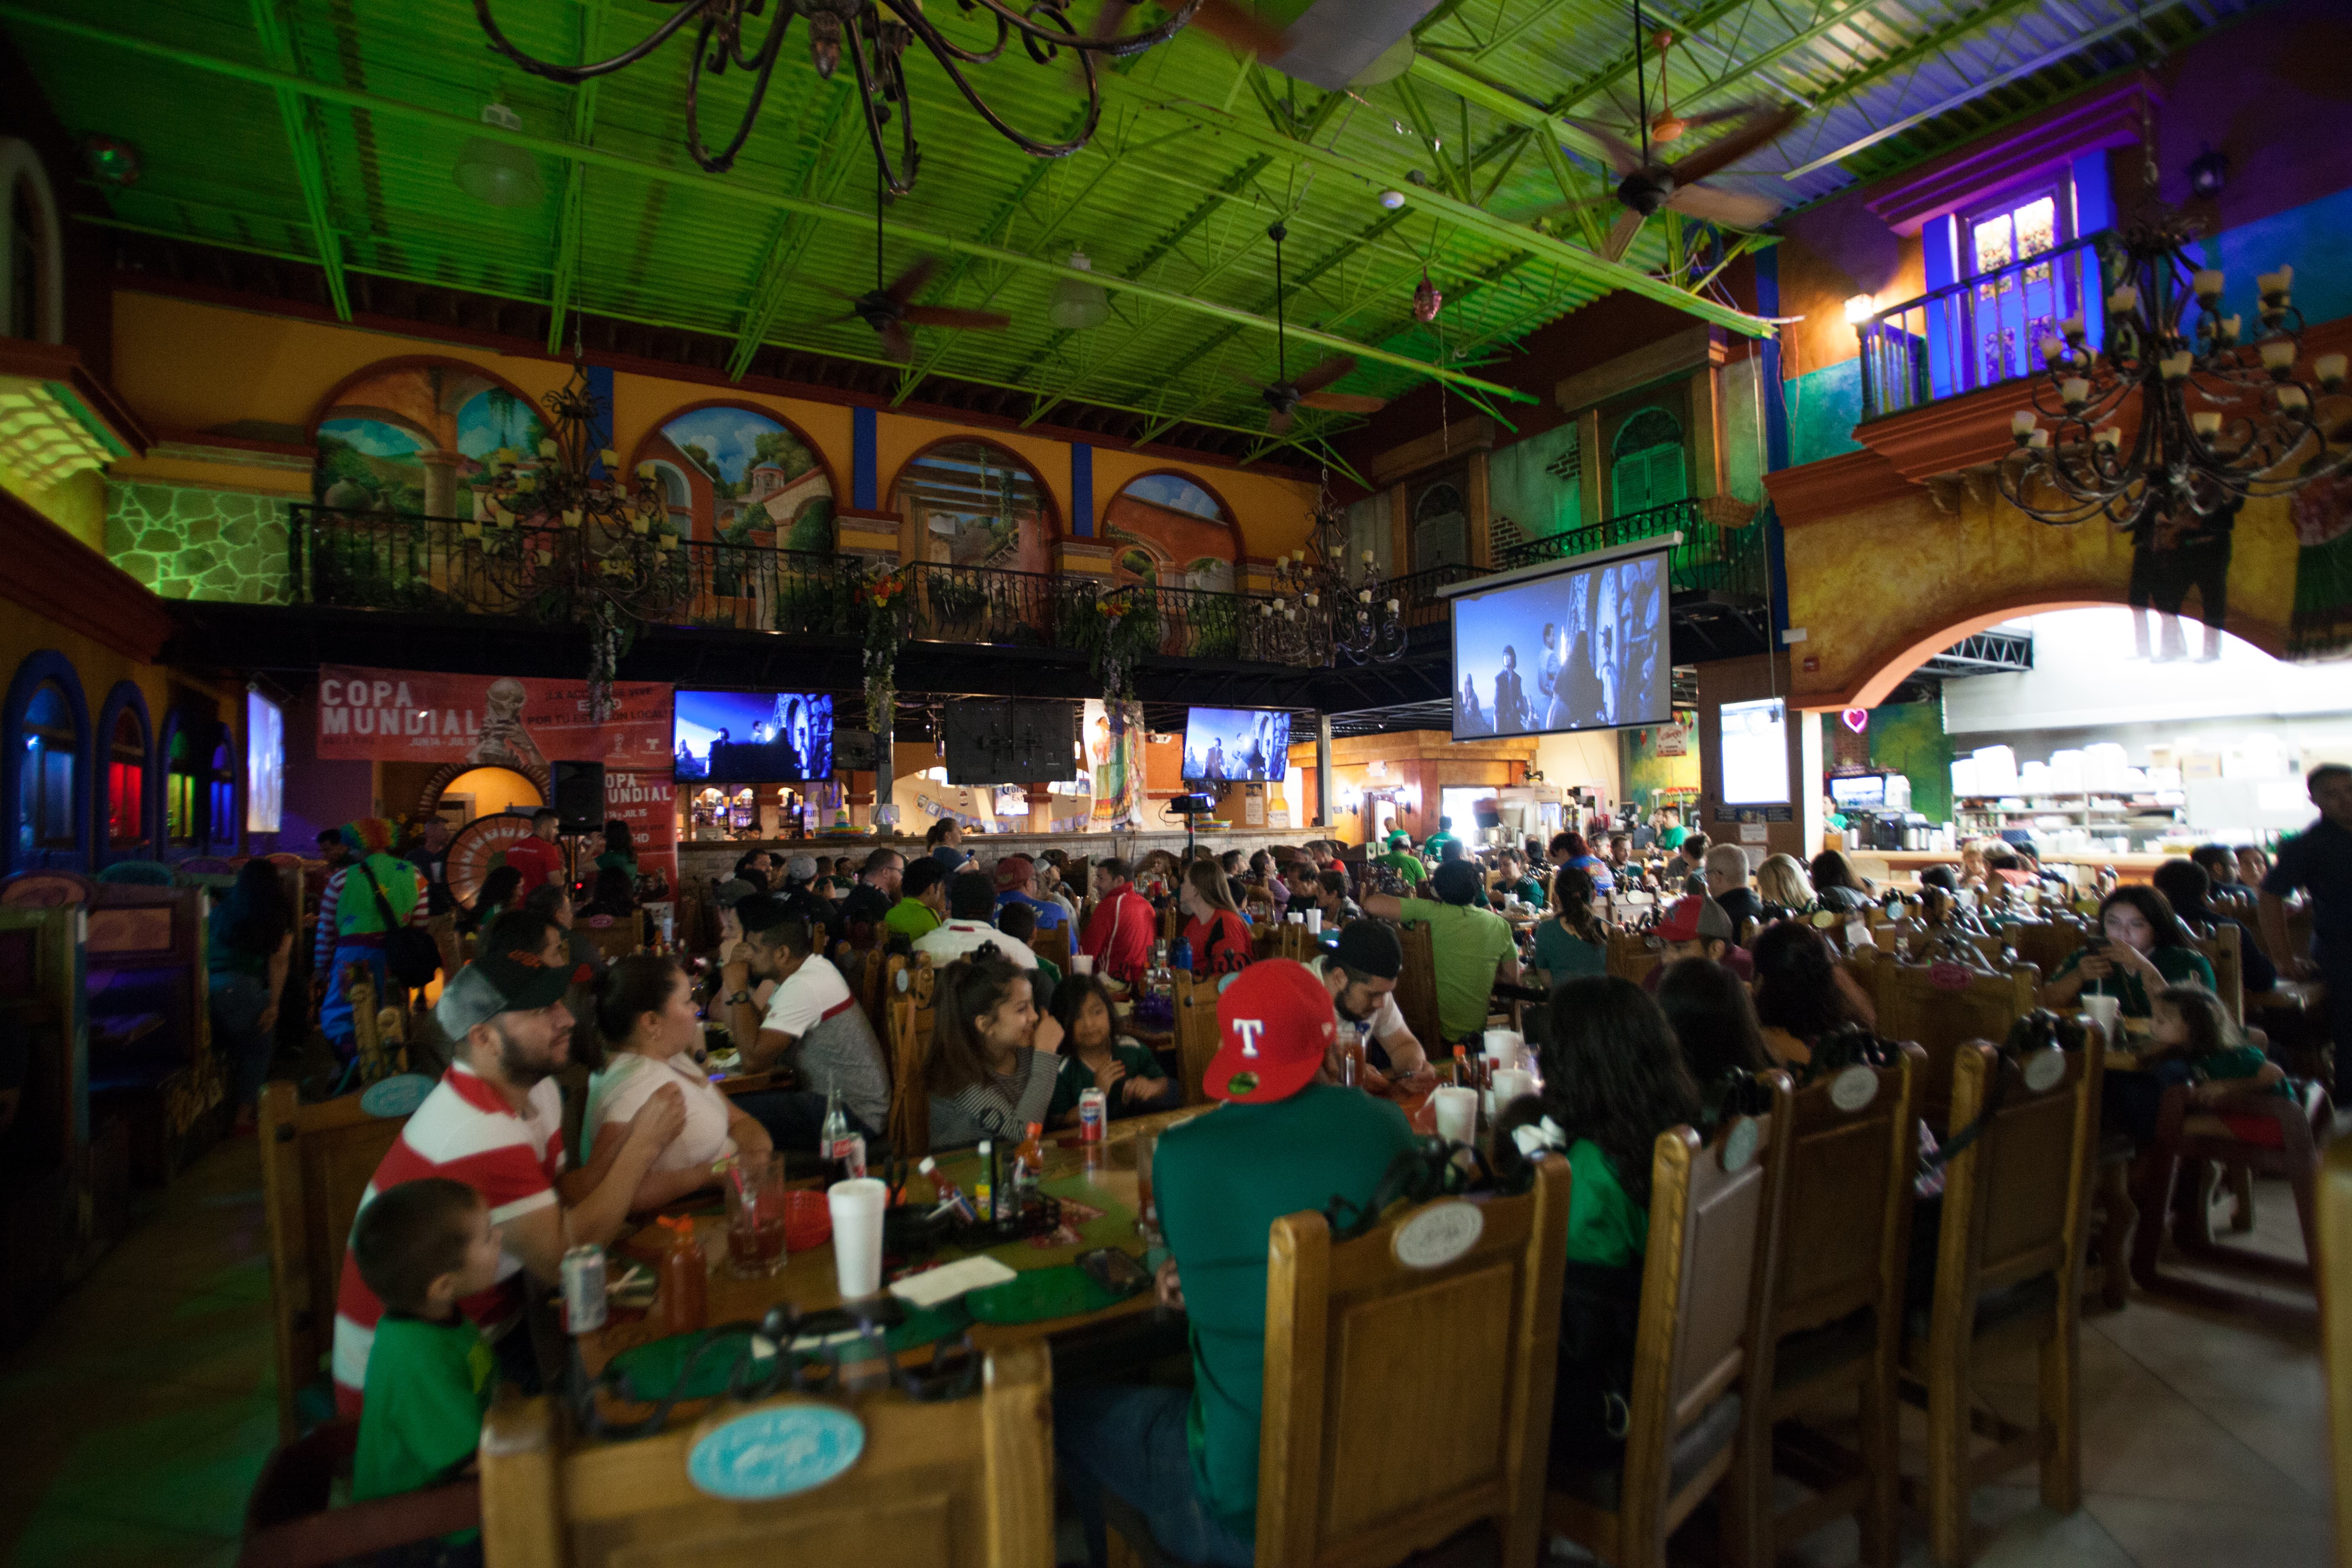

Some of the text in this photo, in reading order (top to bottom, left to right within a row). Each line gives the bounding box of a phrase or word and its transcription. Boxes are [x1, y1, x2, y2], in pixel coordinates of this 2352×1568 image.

[321, 679, 413, 707] COPA
[321, 707, 480, 735] MUNDIAL
[527, 715, 551, 724] POR
[555, 714, 570, 723] TU
[605, 773, 637, 788] OPA
[608, 787, 671, 804] UNDIAL
[1002, 785, 1026, 795] Coro
[622, 809, 637, 818] JUL
[638, 808, 647, 817] 15
[1232, 1018, 1265, 1059] T
